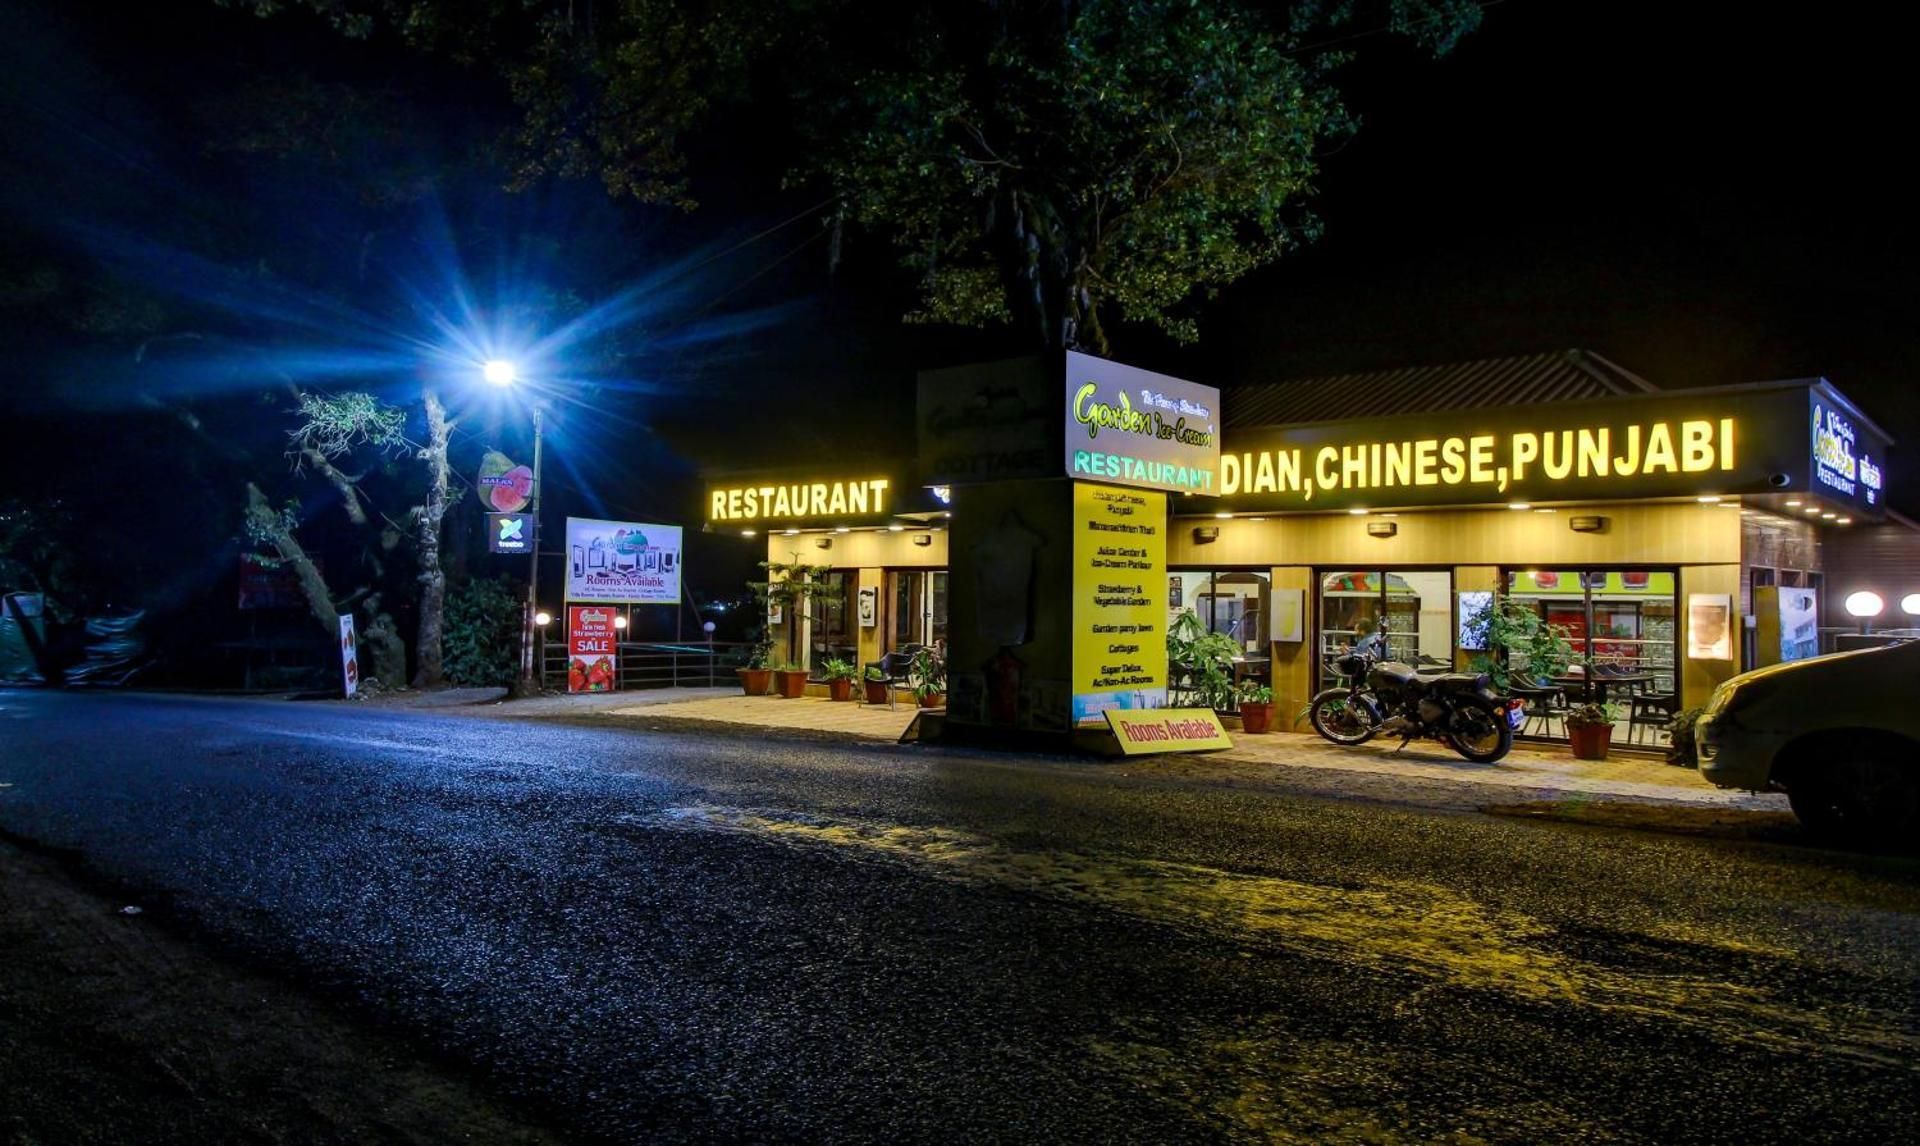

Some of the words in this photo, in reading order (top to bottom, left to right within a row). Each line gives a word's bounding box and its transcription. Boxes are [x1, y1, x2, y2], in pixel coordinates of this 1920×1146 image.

[1074, 381, 1152, 439] Garden
[1074, 449, 1214, 490] RESTAURANT
[1820, 467, 1855, 496] RESTAURANT
[712, 479, 888, 520] RESTAURANT
[1141, 549, 1147, 557] &
[586, 574, 621, 586] Rooms
[625, 576, 664, 587] Available
[1137, 585, 1142, 593] &
[577, 641, 608, 651] SALE
[1120, 720, 1168, 742] Rooms
[1165, 718, 1219, 741] Available
